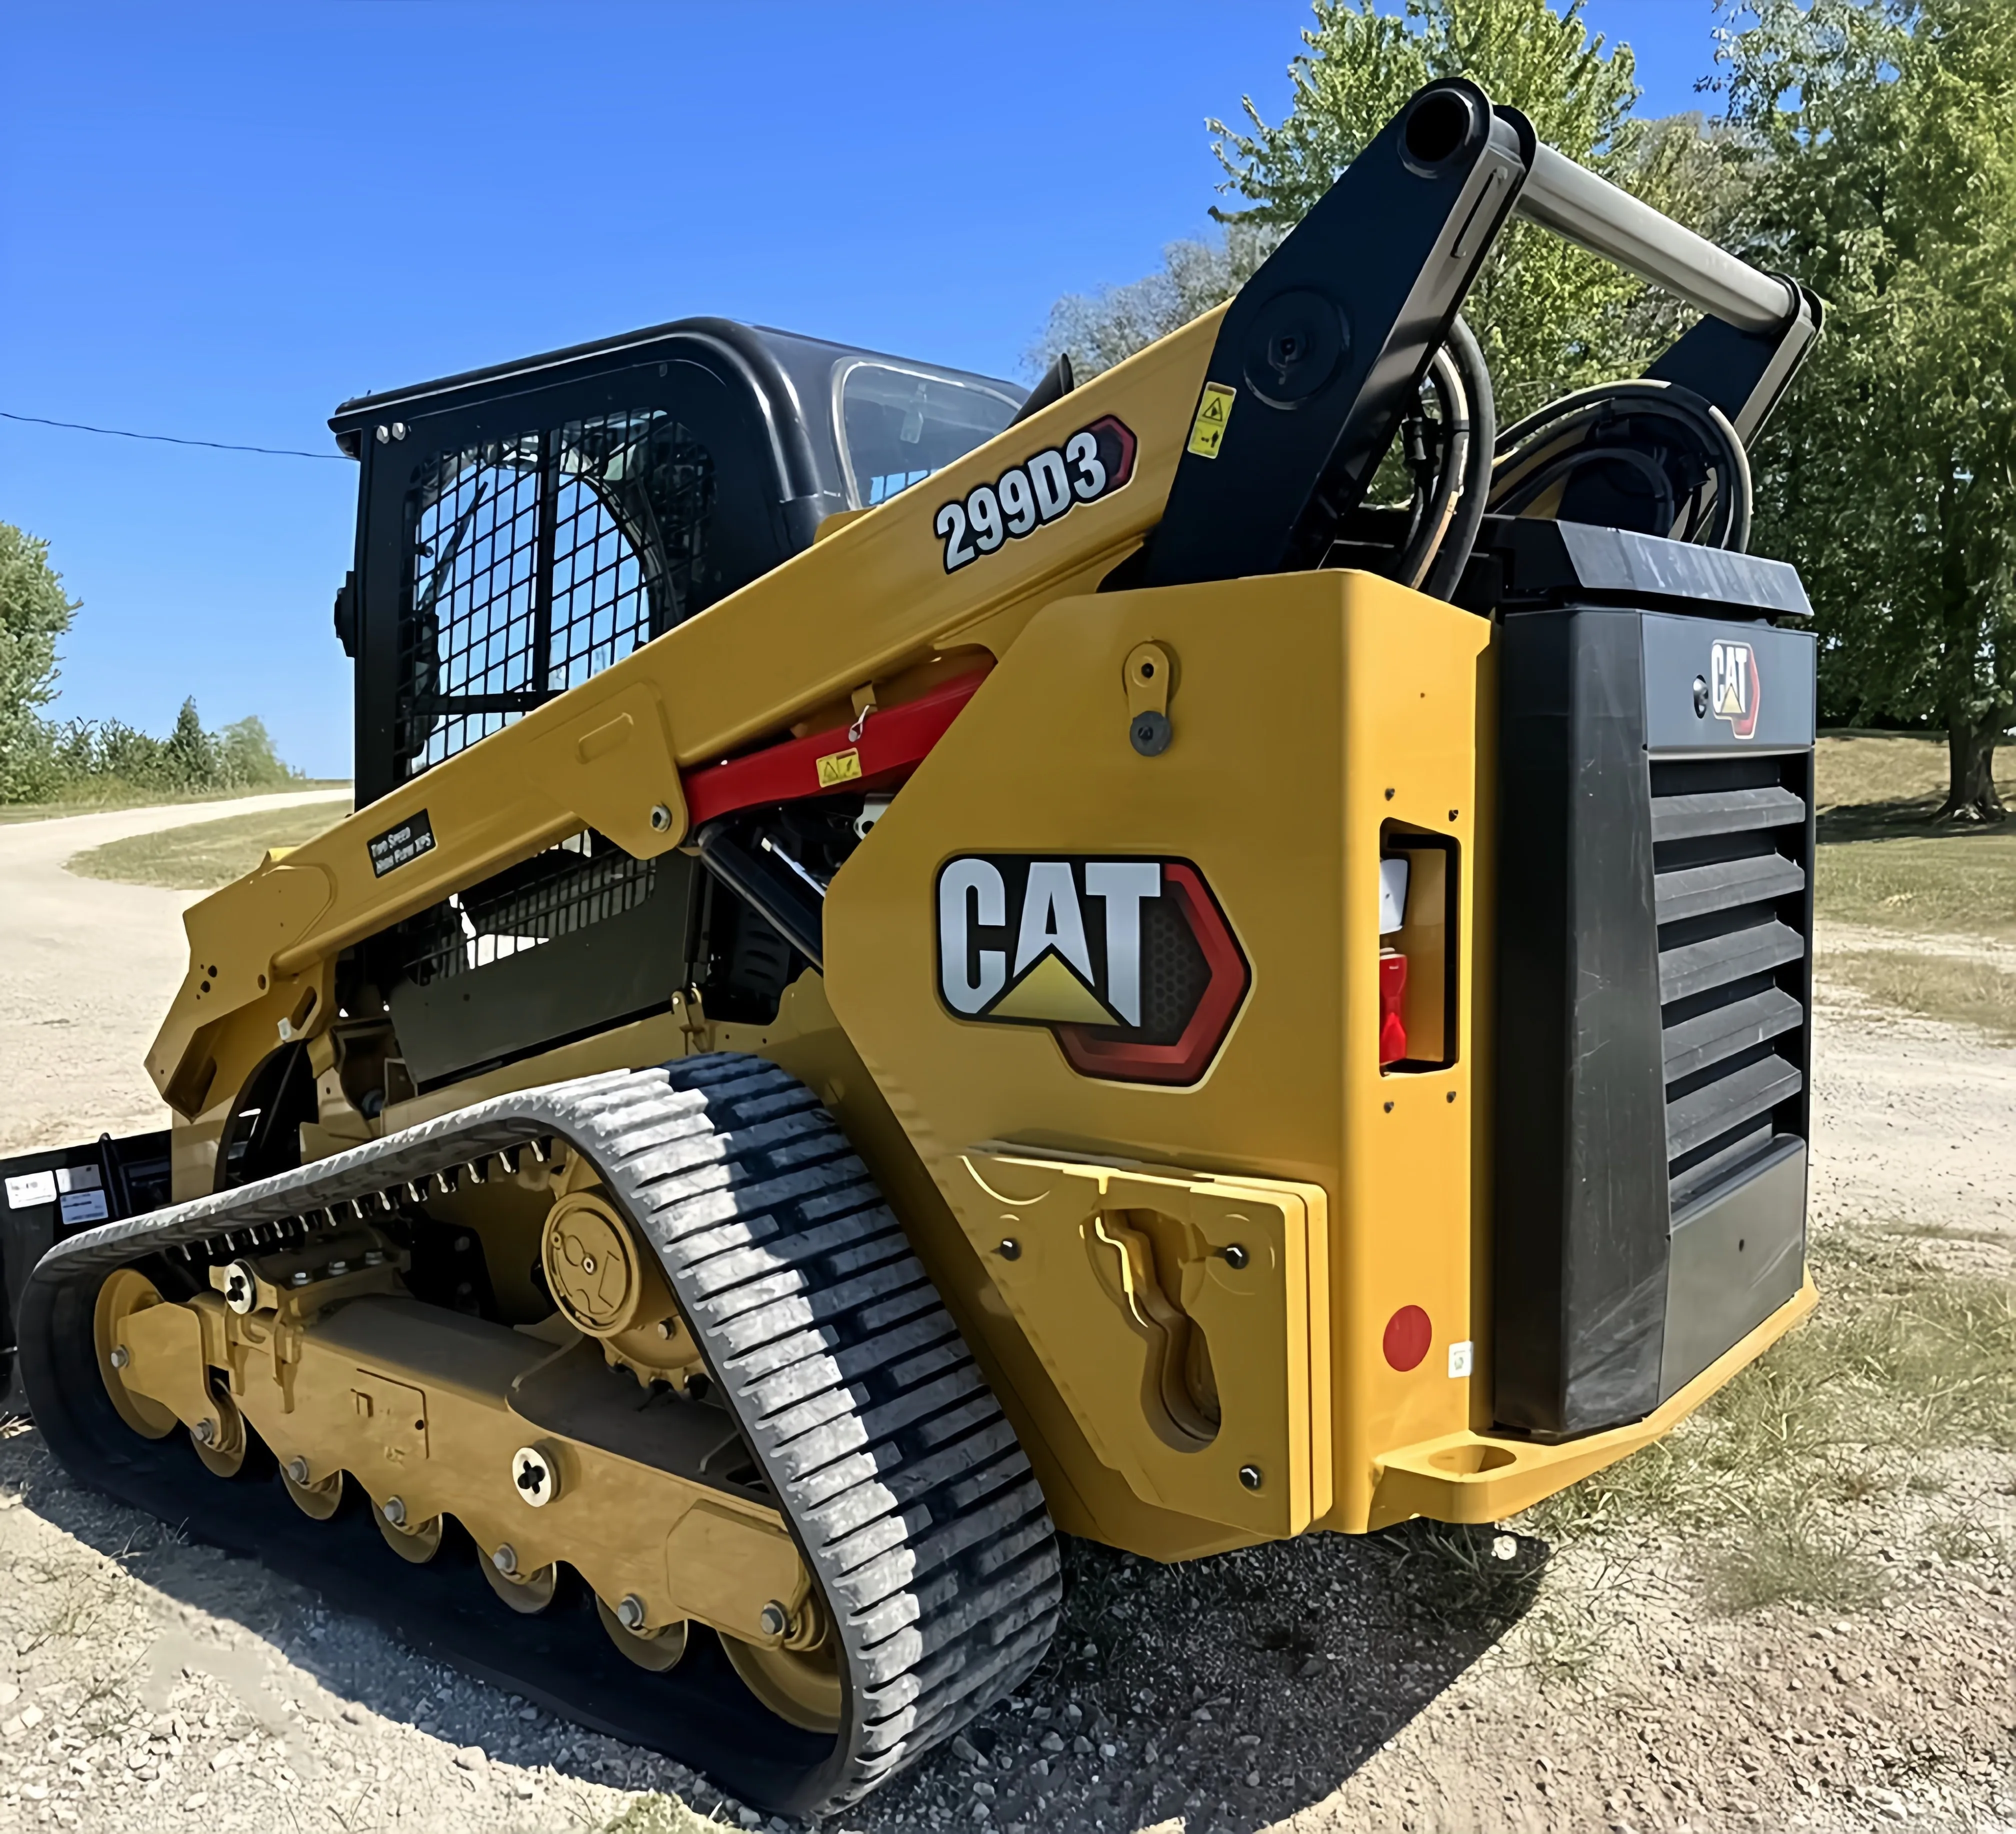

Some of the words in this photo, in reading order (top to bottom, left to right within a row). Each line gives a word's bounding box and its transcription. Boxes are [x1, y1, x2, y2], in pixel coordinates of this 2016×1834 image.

[937, 432, 1106, 570] 299D3
[1712, 644, 1747, 713] CAT
[940, 858, 1160, 1027] CAT
